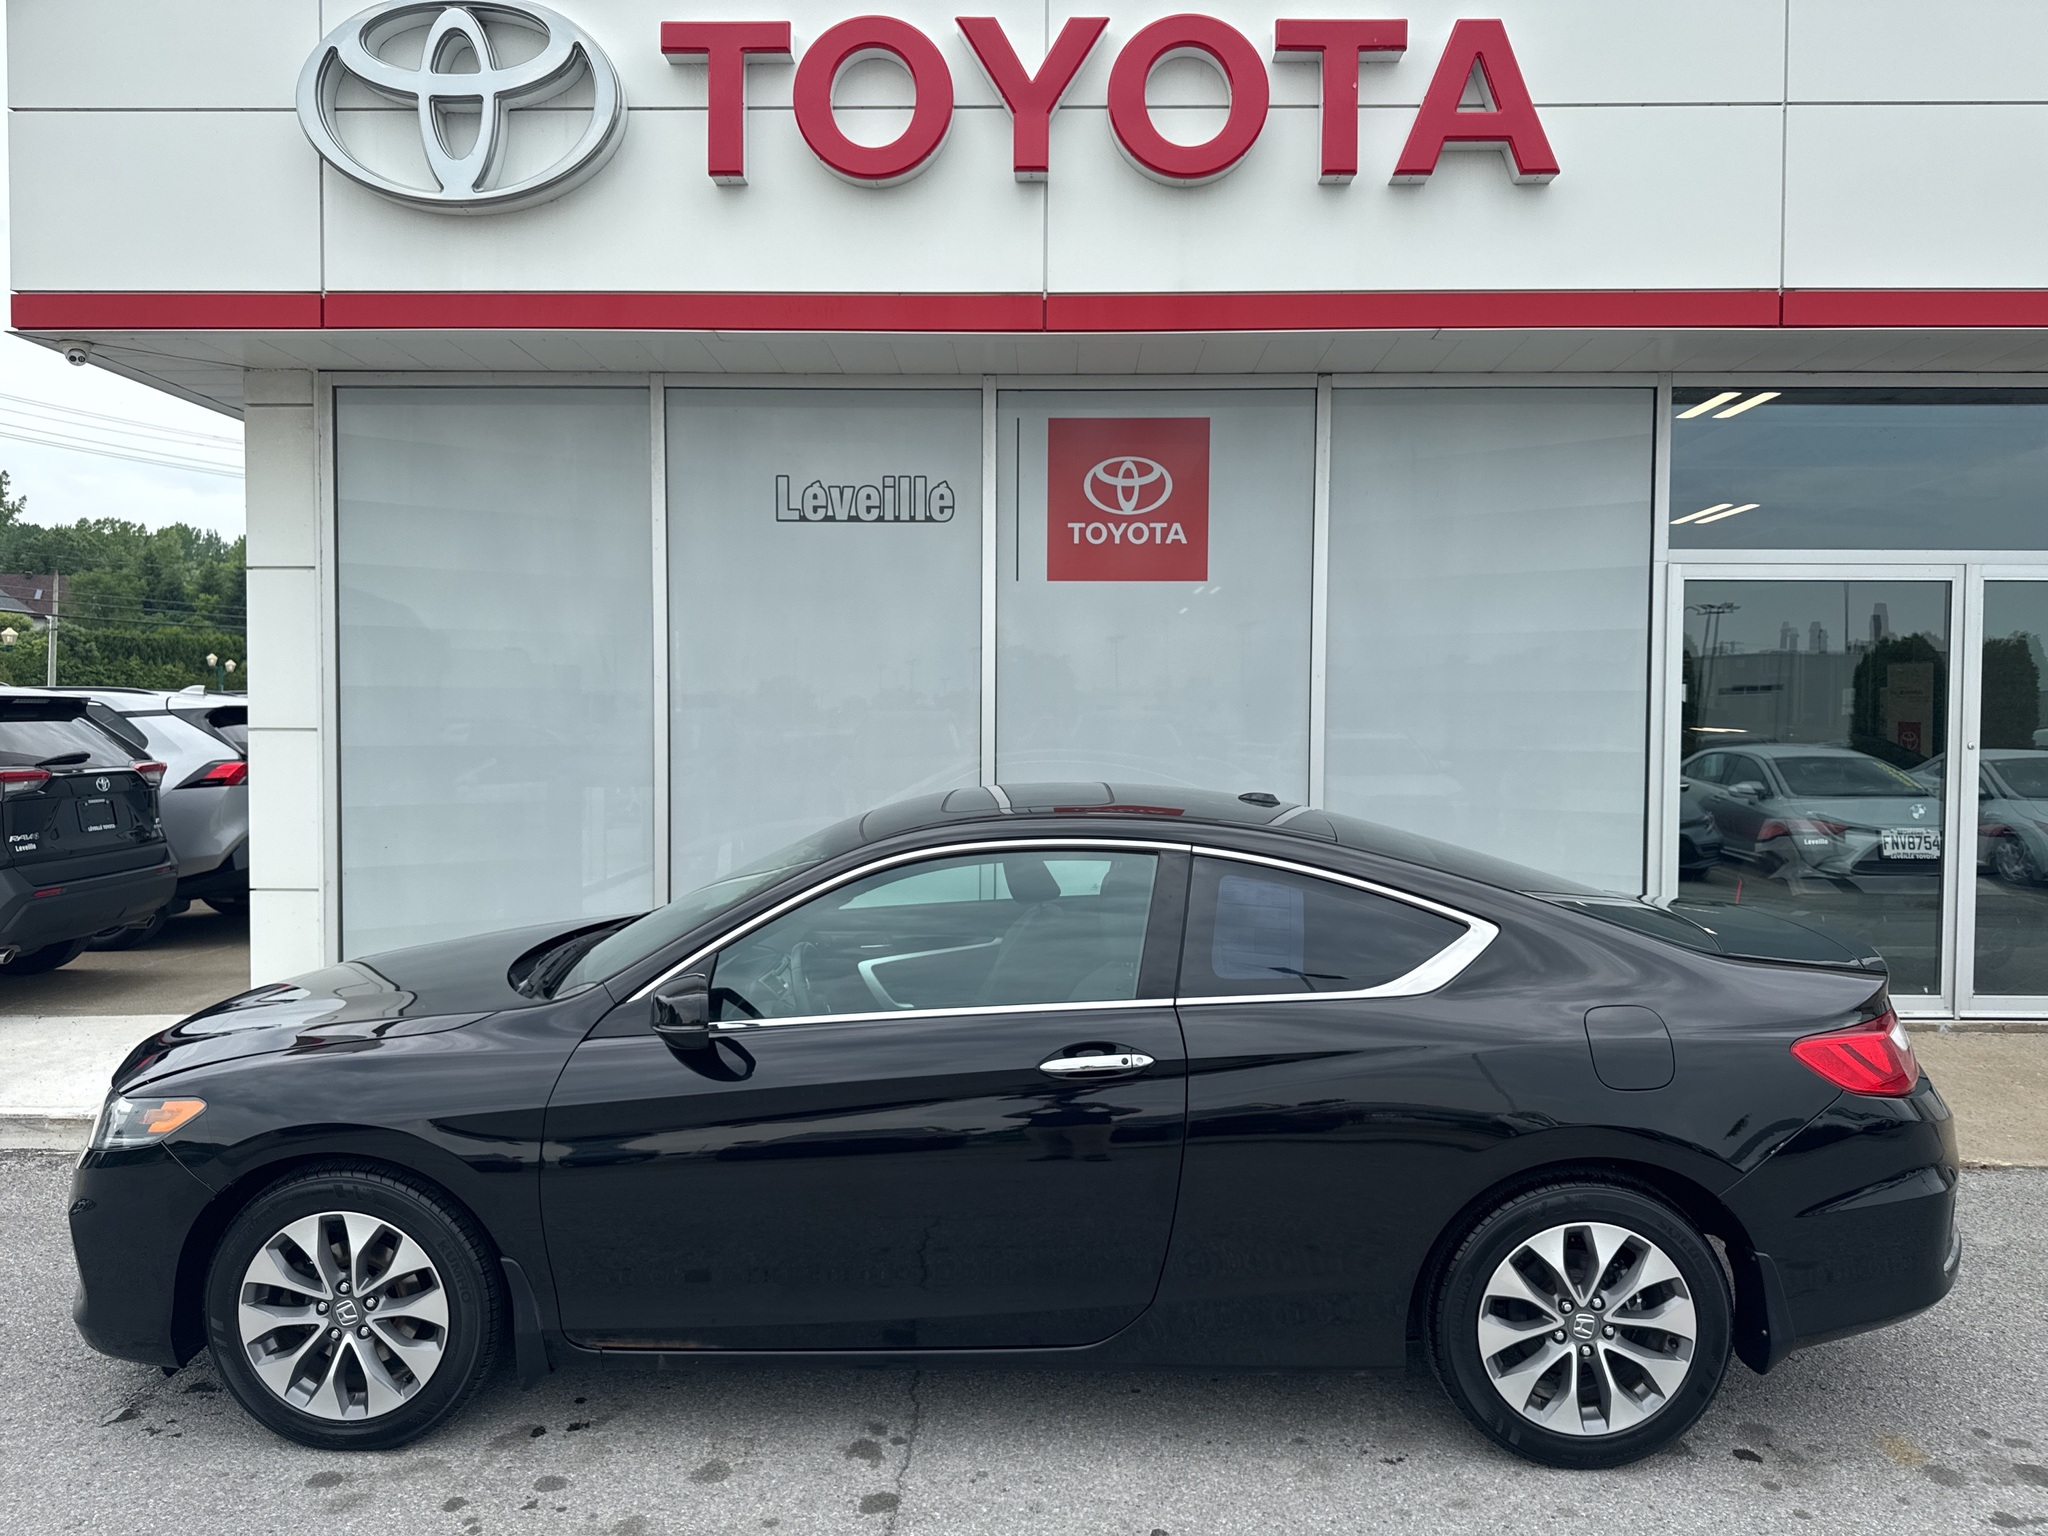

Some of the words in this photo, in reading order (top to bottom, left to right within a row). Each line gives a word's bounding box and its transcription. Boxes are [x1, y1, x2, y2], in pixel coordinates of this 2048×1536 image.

[660, 13, 1560, 186] TOYOTA
[775, 474, 955, 522] Léveillé
[1067, 522, 1188, 545] TOYOTA
[1883, 835, 1940, 850] FNV8754
[435, 1238, 473, 1304] KUMHO
